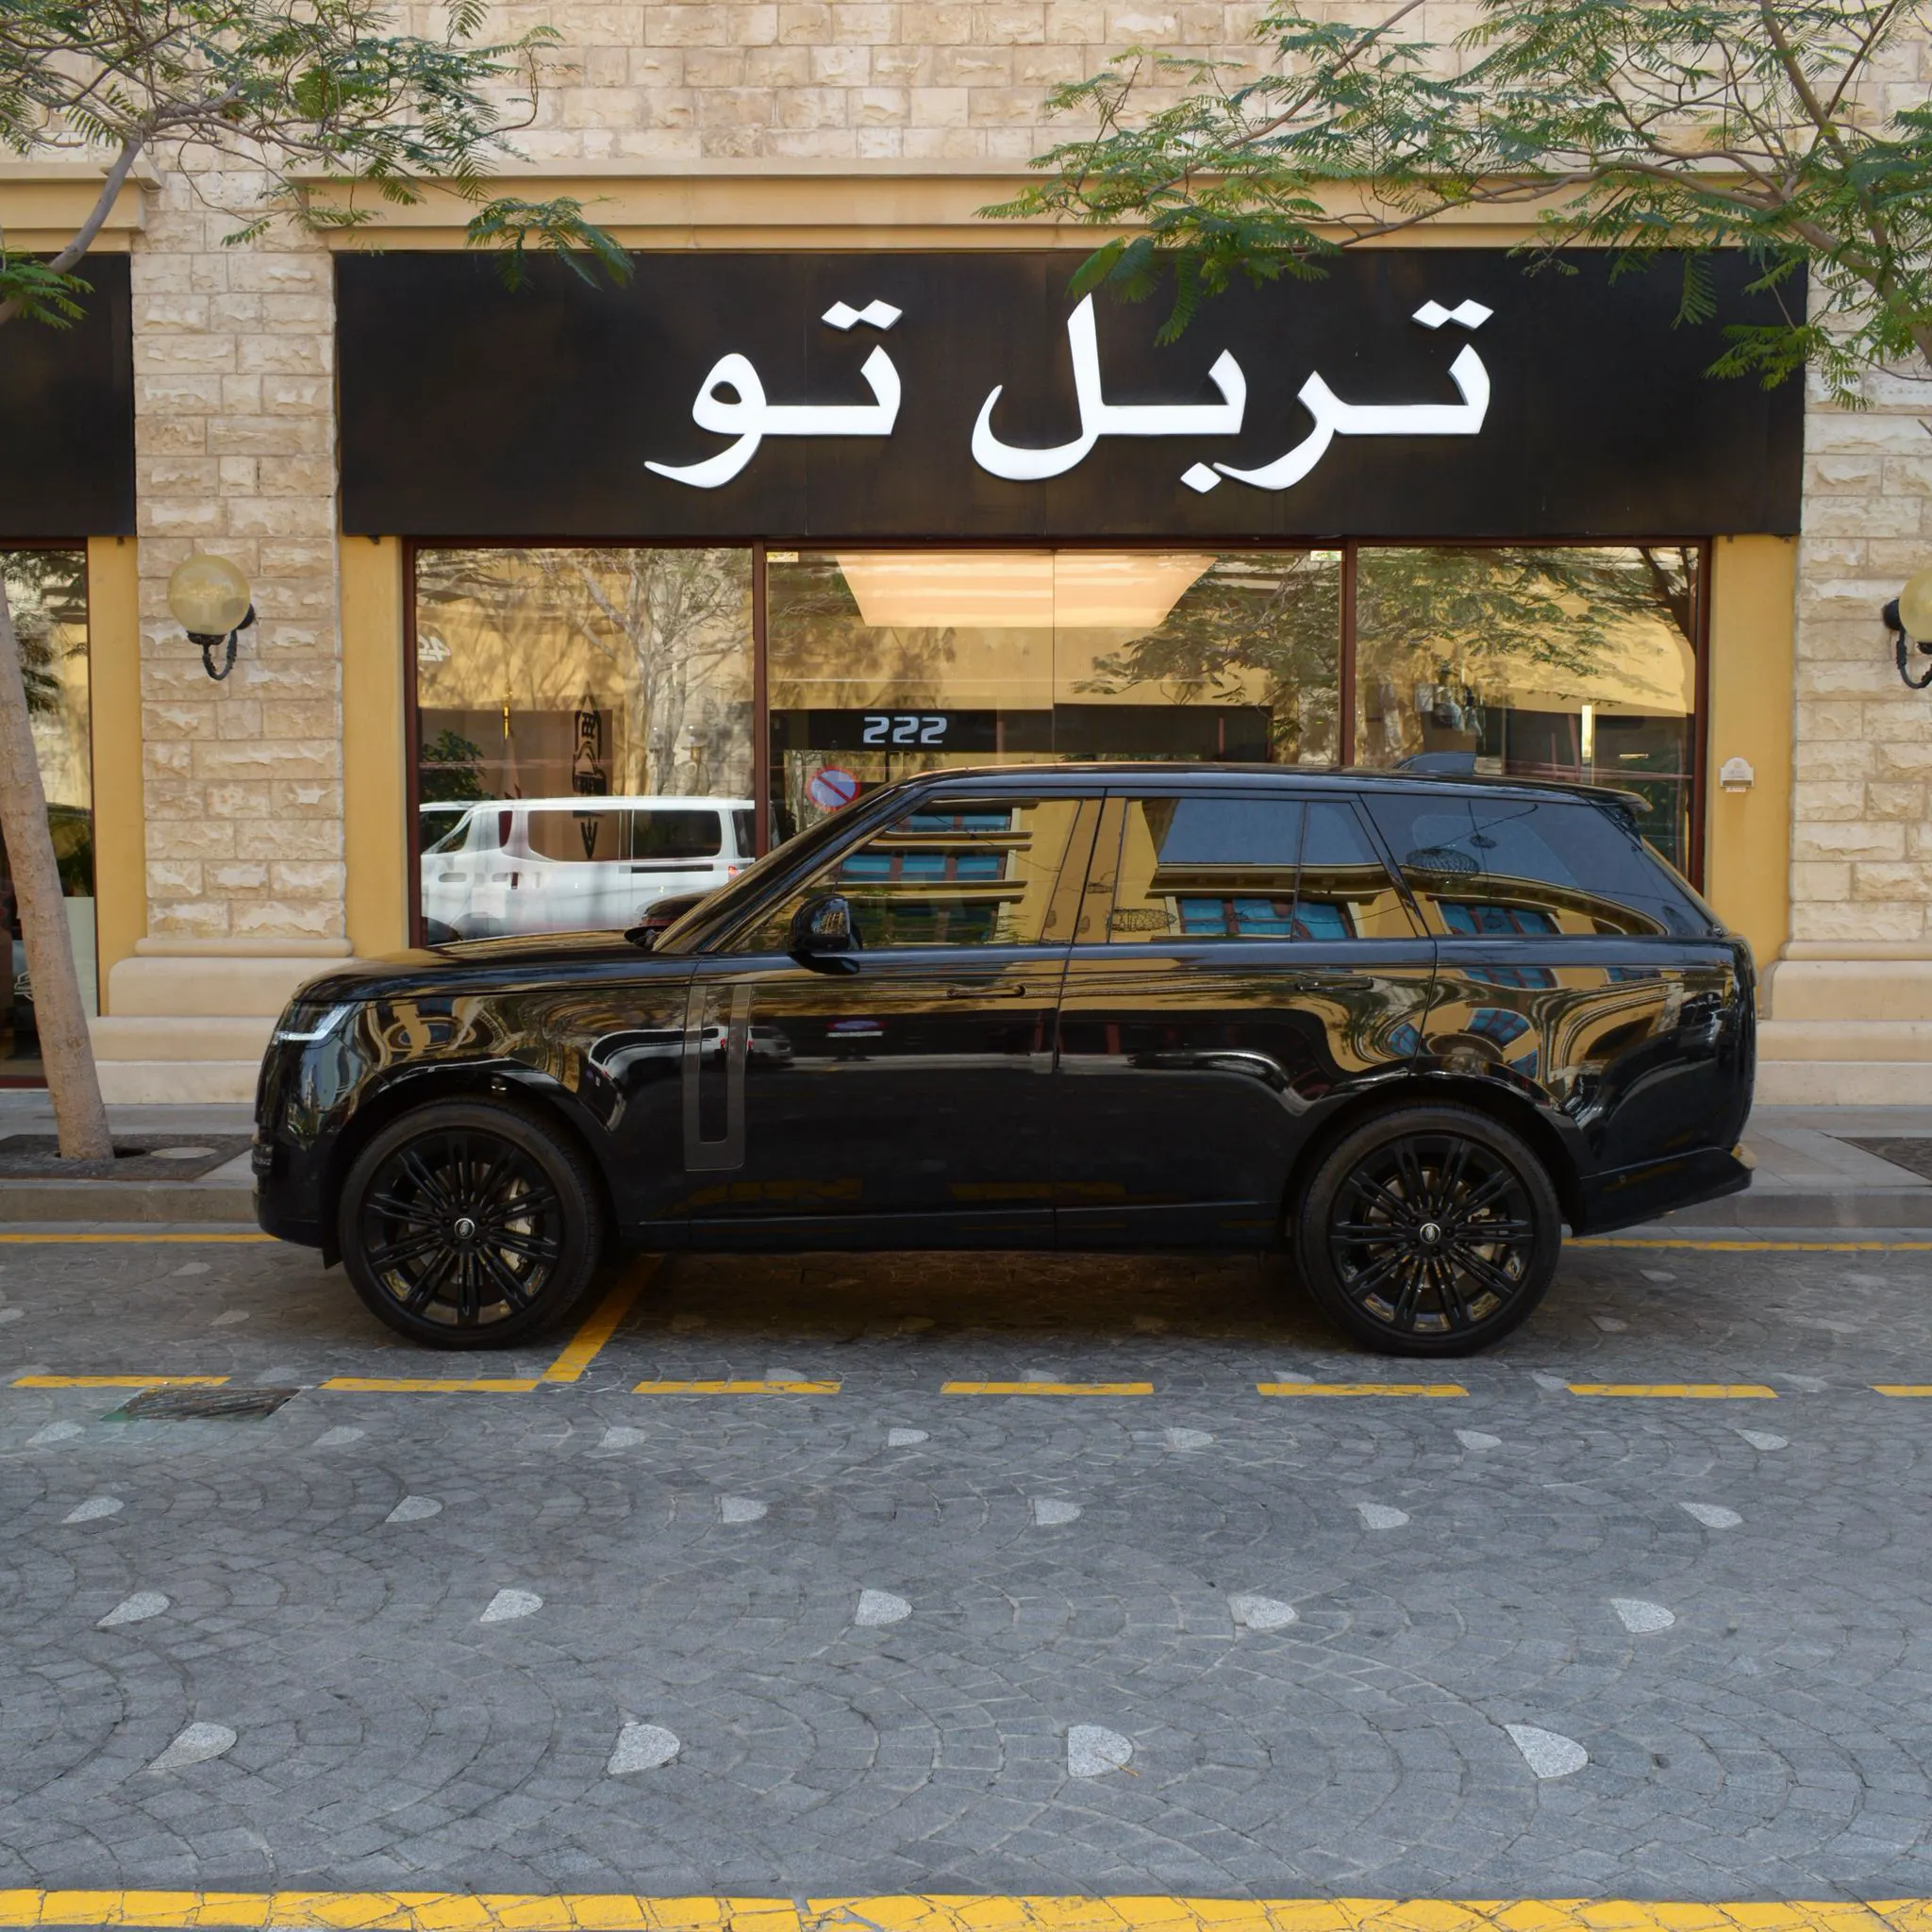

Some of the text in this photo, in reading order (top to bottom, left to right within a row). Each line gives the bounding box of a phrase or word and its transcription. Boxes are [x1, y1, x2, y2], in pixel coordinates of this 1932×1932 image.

[643, 293, 1495, 493] تربل تو
[862, 716, 948, 744] 222
